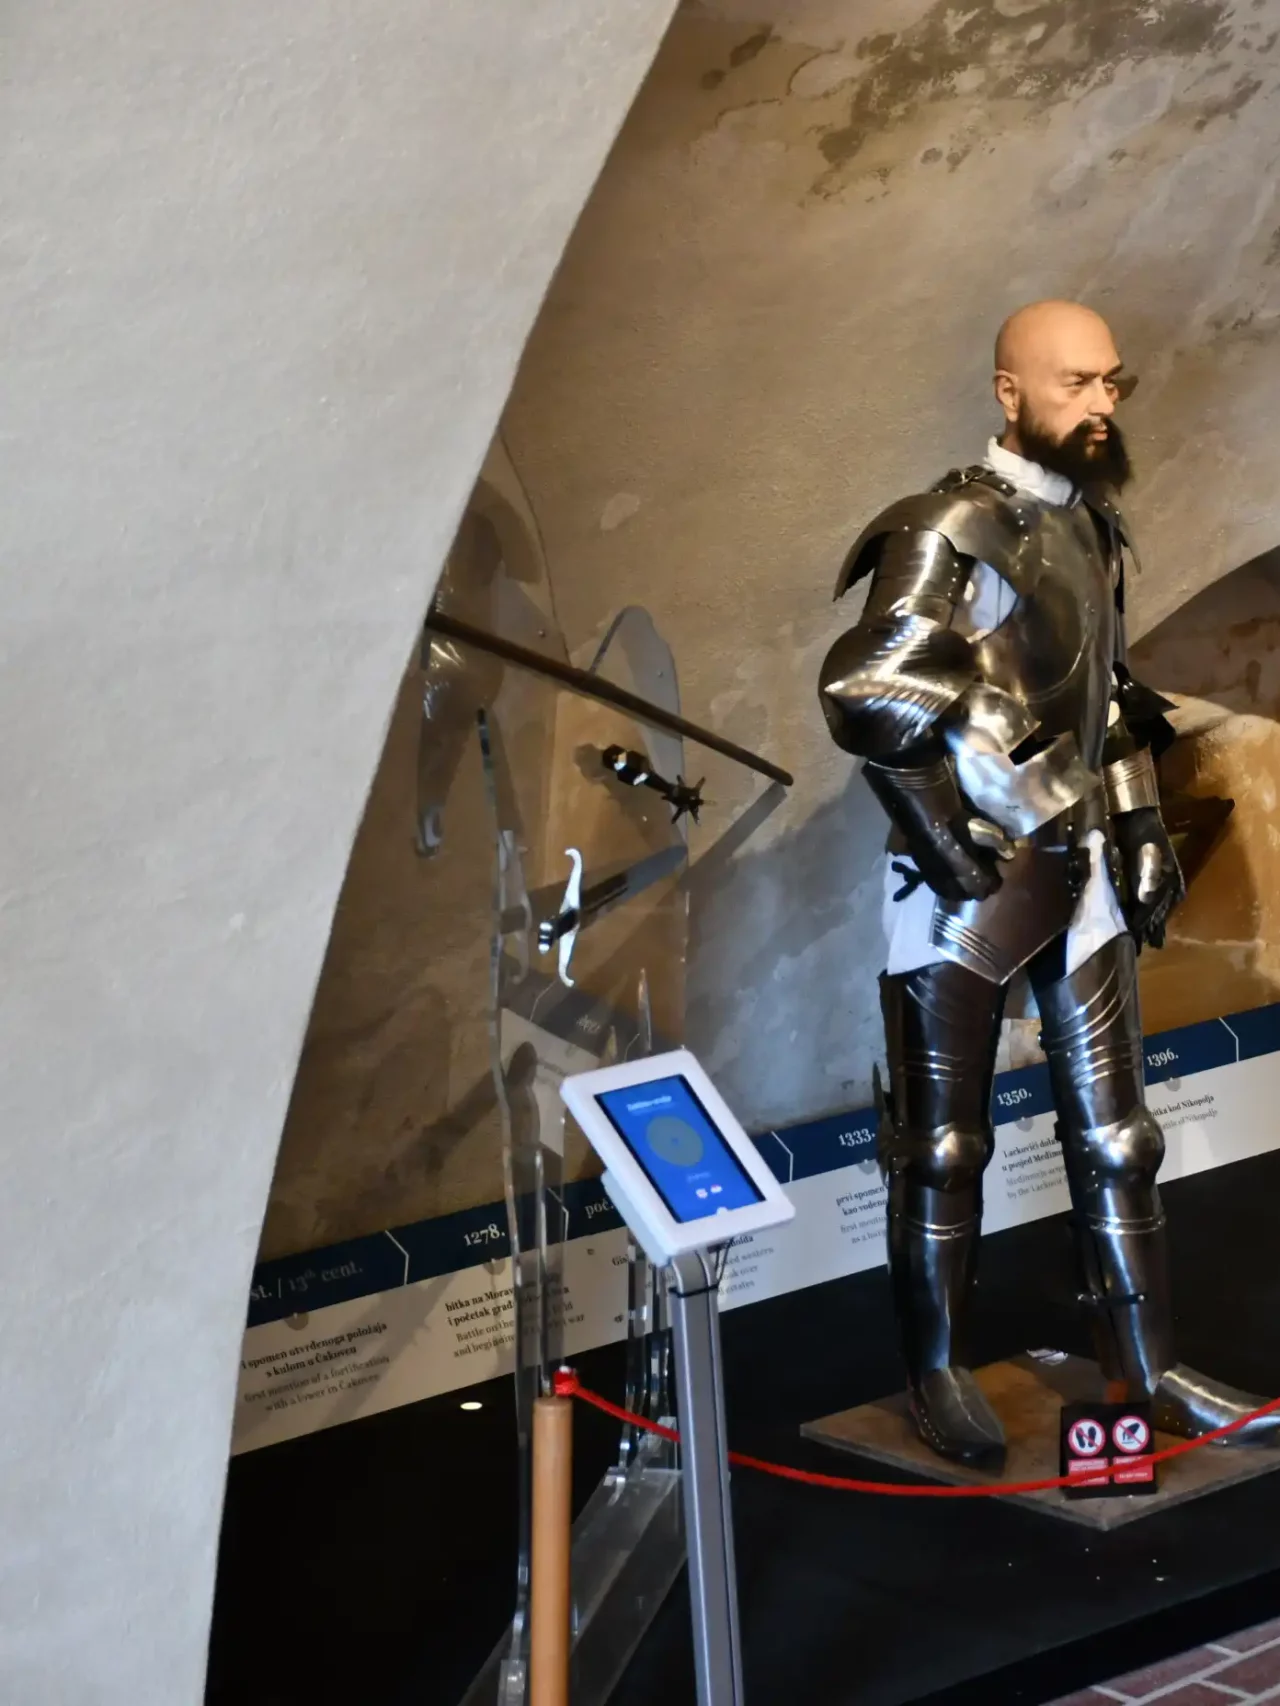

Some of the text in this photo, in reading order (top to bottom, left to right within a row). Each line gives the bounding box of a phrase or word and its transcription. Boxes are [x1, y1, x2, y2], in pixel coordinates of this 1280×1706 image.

[1146, 1047, 1179, 1067] 1396.
[997, 1087, 1032, 1106] 1350.
[838, 1128, 876, 1147] 1333.
[854, 1186, 885, 1201] spomen
[842, 1206, 858, 1216] kao
[464, 1223, 506, 1247] 1278.
[321, 1260, 363, 1282] cent.
[445, 1299, 470, 1312] bitka
[472, 1296, 484, 1305] na
[453, 1307, 490, 1327] početak
[456, 1327, 484, 1342] Battle
[453, 1344, 472, 1358] and
[273, 1361, 306, 1376] kulom
